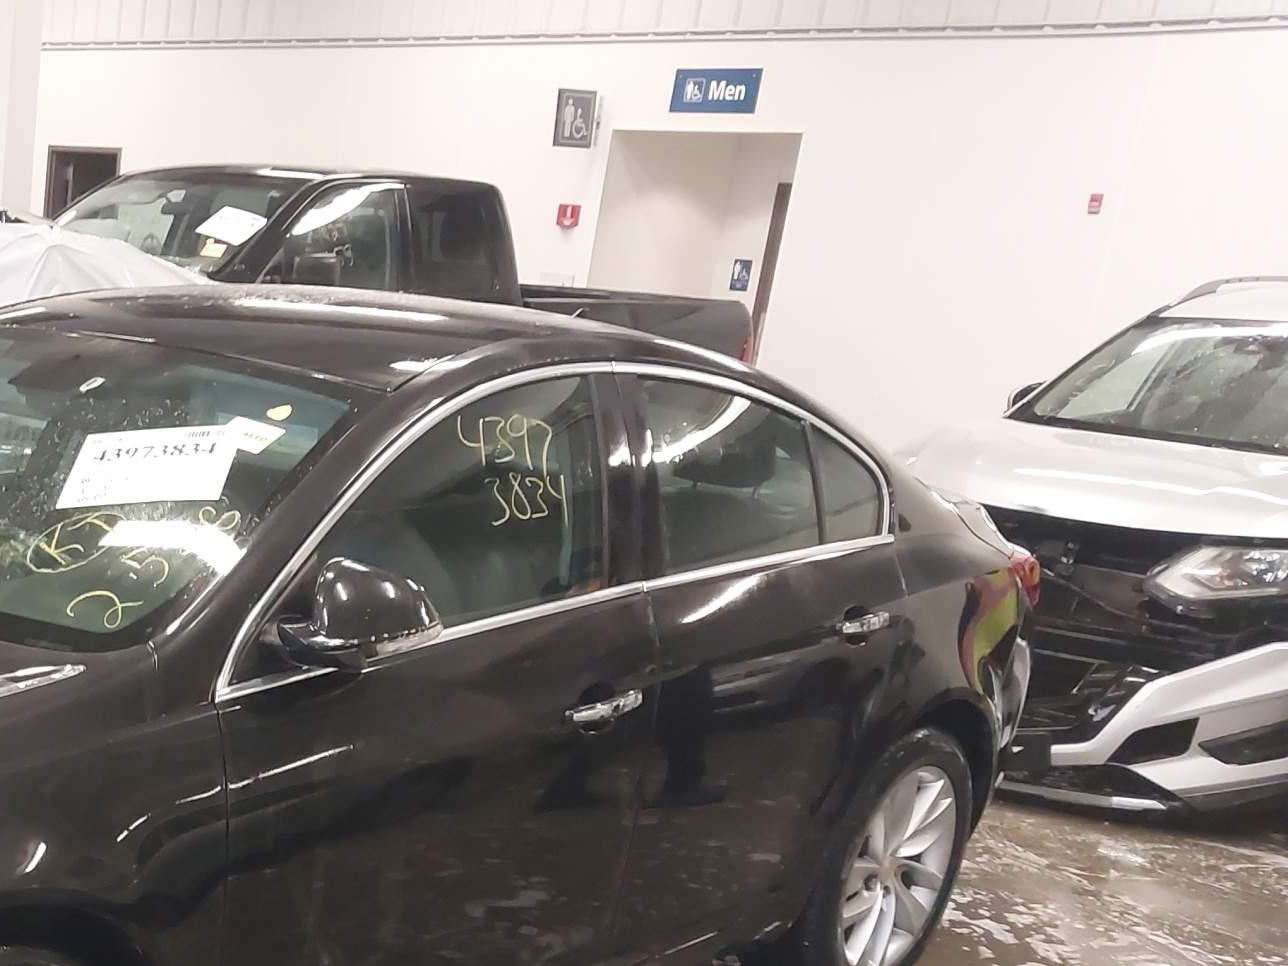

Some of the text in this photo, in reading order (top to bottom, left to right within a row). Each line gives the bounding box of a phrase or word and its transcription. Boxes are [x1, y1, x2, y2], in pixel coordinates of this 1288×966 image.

[708, 80, 746, 101] Men
[458, 414, 553, 476] 4397
[483, 472, 570, 528] 3834
